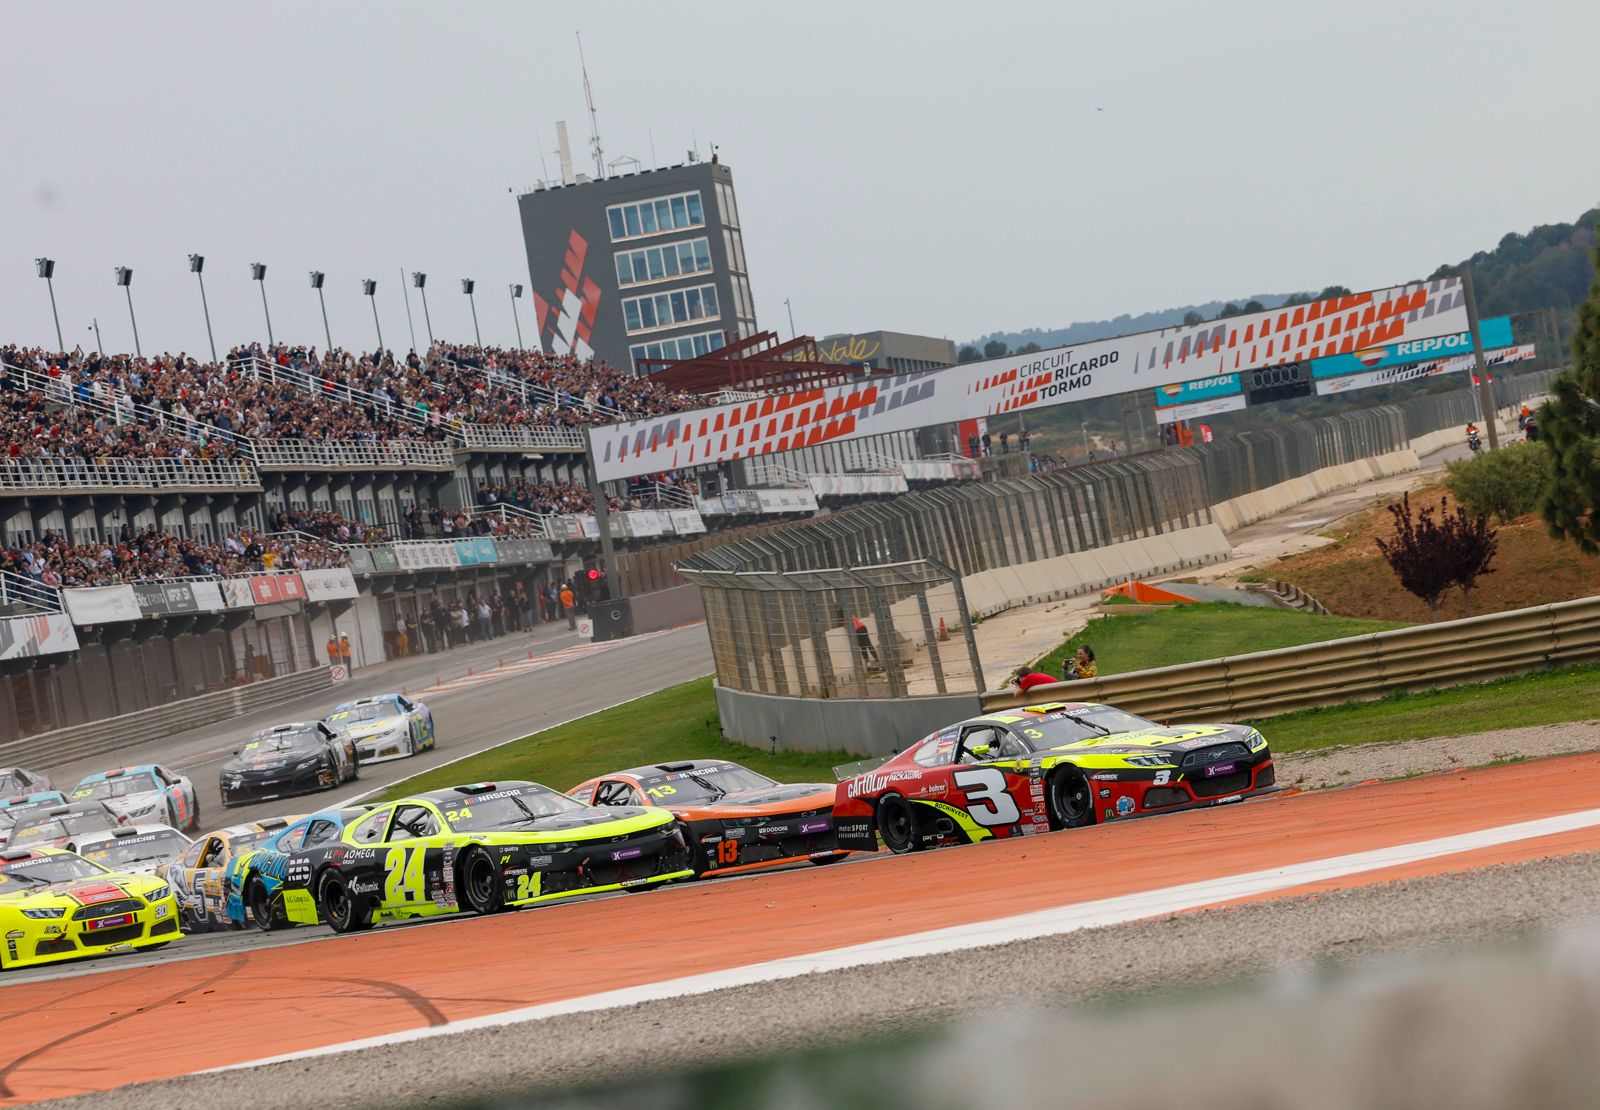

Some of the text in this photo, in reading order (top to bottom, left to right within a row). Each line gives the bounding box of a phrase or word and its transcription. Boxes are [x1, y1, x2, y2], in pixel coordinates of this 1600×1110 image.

[1396, 333, 1468, 356] REPSOL
[1019, 350, 1073, 378] CIRCUIT
[1055, 351, 1119, 381] RICARDO
[1039, 374, 1091, 400] TORMO
[1188, 375, 1234, 391] REPSOL
[1023, 728, 1043, 739] 3
[888, 769, 923, 782] PACKAGING
[1153, 770, 1172, 785] 3
[478, 789, 522, 803] NASCAR
[646, 785, 677, 798] 13
[952, 768, 1020, 827] 3
[445, 807, 473, 822] 24
[117, 835, 156, 847] NASCAR
[323, 849, 376, 861] ALPHAOMEGA
[717, 840, 739, 864] 13
[10, 857, 52, 870] NASCAR
[384, 844, 428, 907] 24
[517, 871, 542, 900] 24
[155, 904, 168, 919] 30
